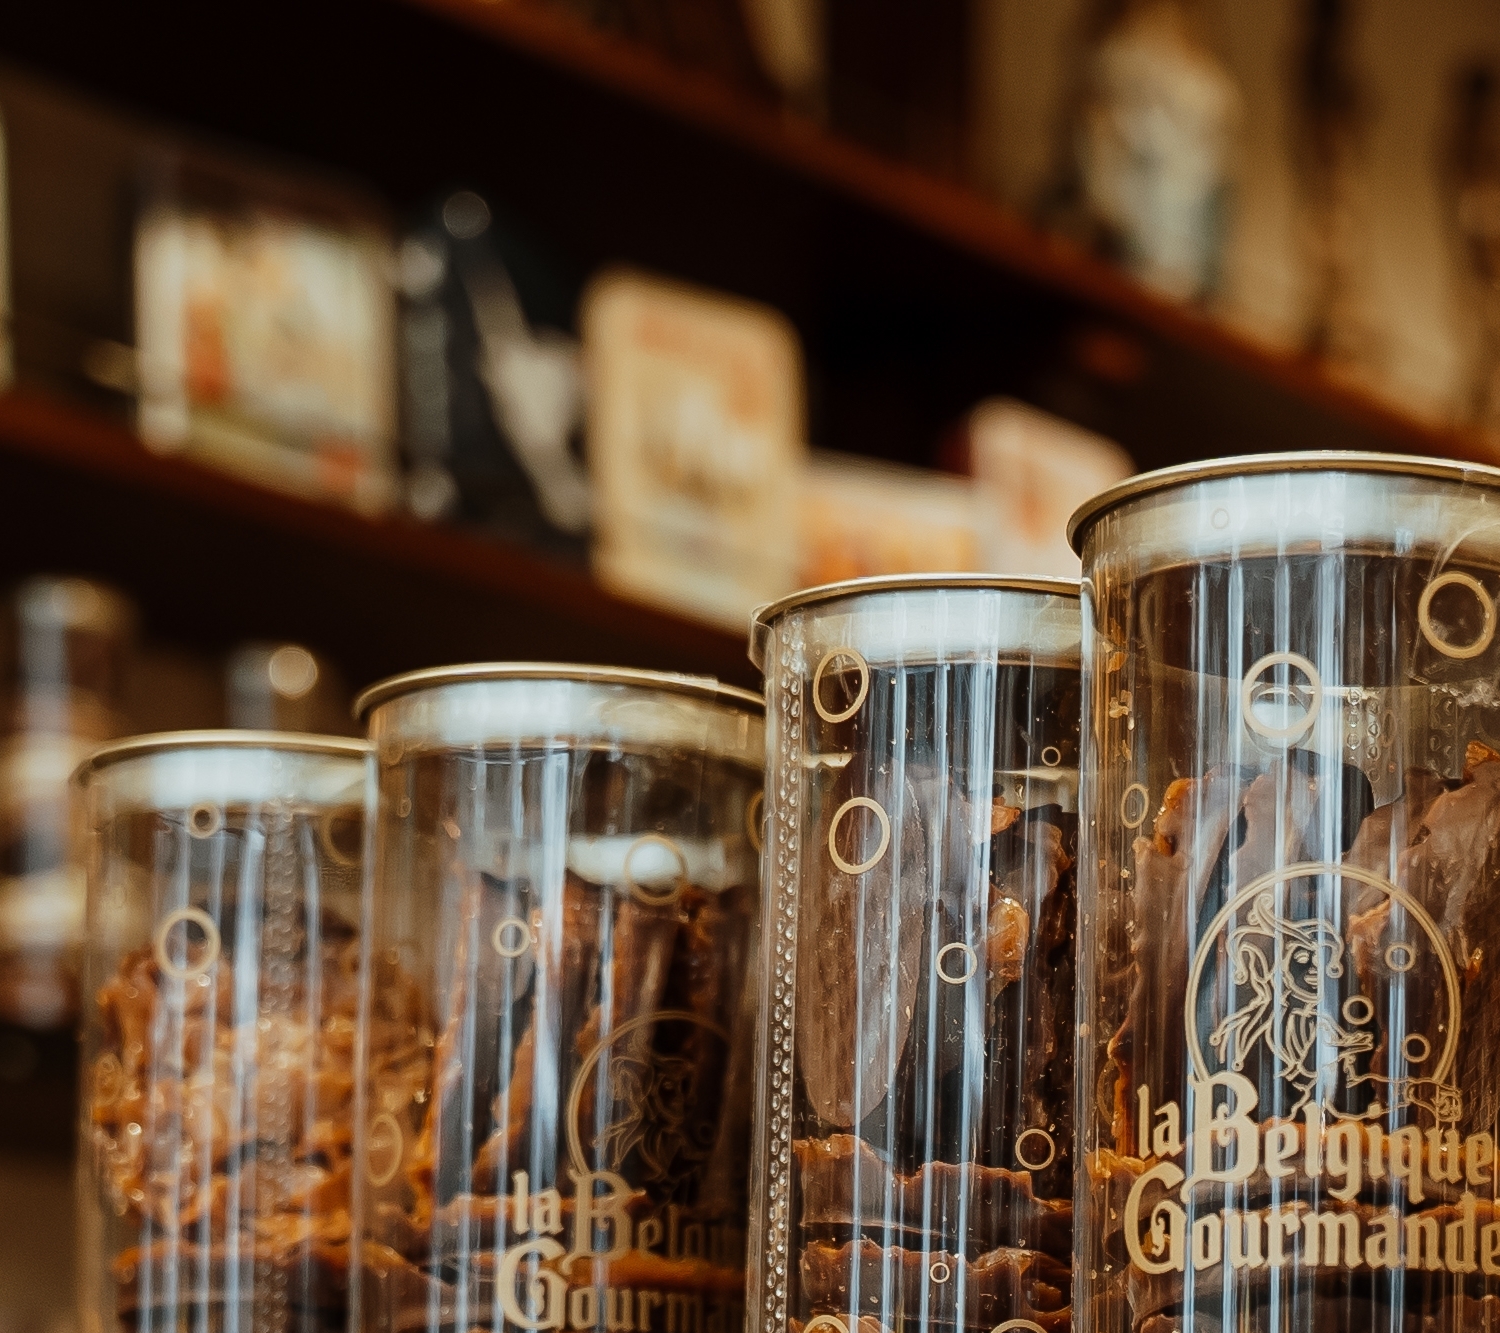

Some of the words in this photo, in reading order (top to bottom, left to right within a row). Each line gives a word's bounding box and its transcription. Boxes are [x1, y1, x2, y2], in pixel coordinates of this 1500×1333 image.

[1137, 1083, 1184, 1159] la
[1180, 1070, 1494, 1205] Belgique
[512, 1169, 564, 1236] la
